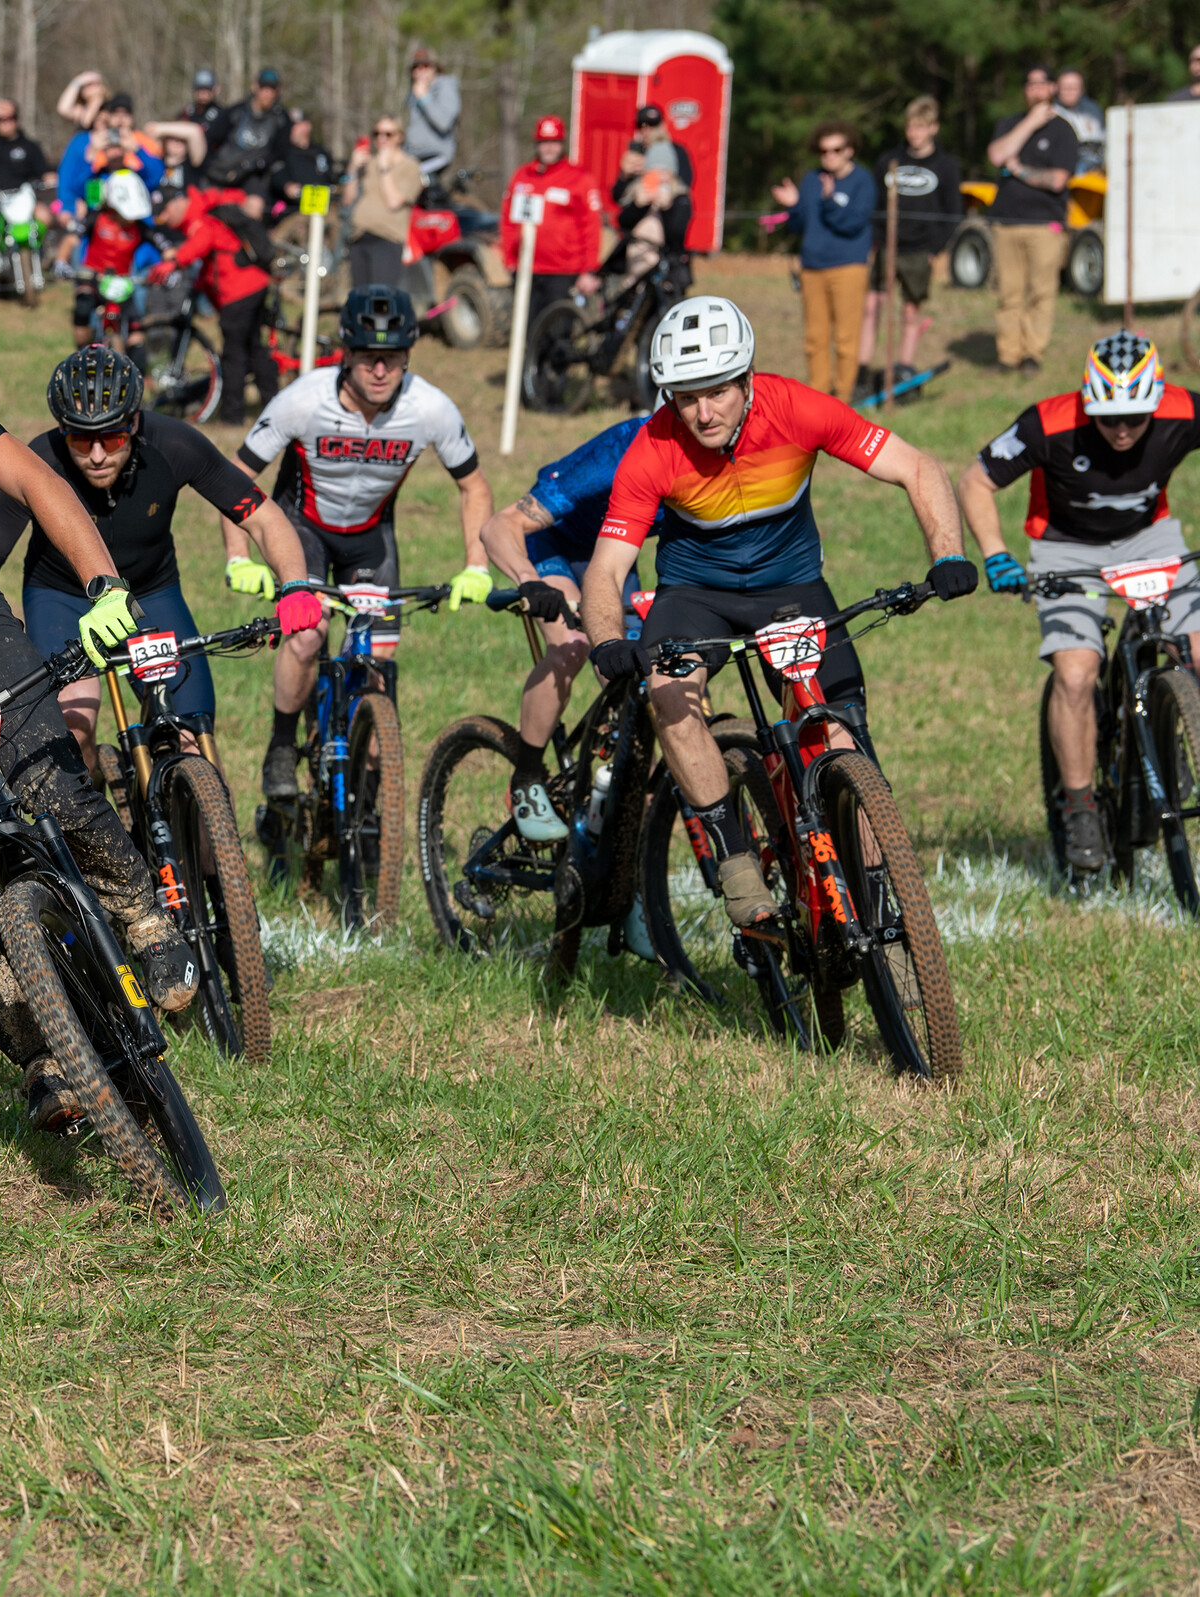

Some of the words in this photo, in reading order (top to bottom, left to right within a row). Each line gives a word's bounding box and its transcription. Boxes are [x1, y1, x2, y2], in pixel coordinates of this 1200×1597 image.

[319, 436, 411, 460] GEAR
[864, 428, 884, 457] GIRO
[601, 524, 627, 537] GIRO
